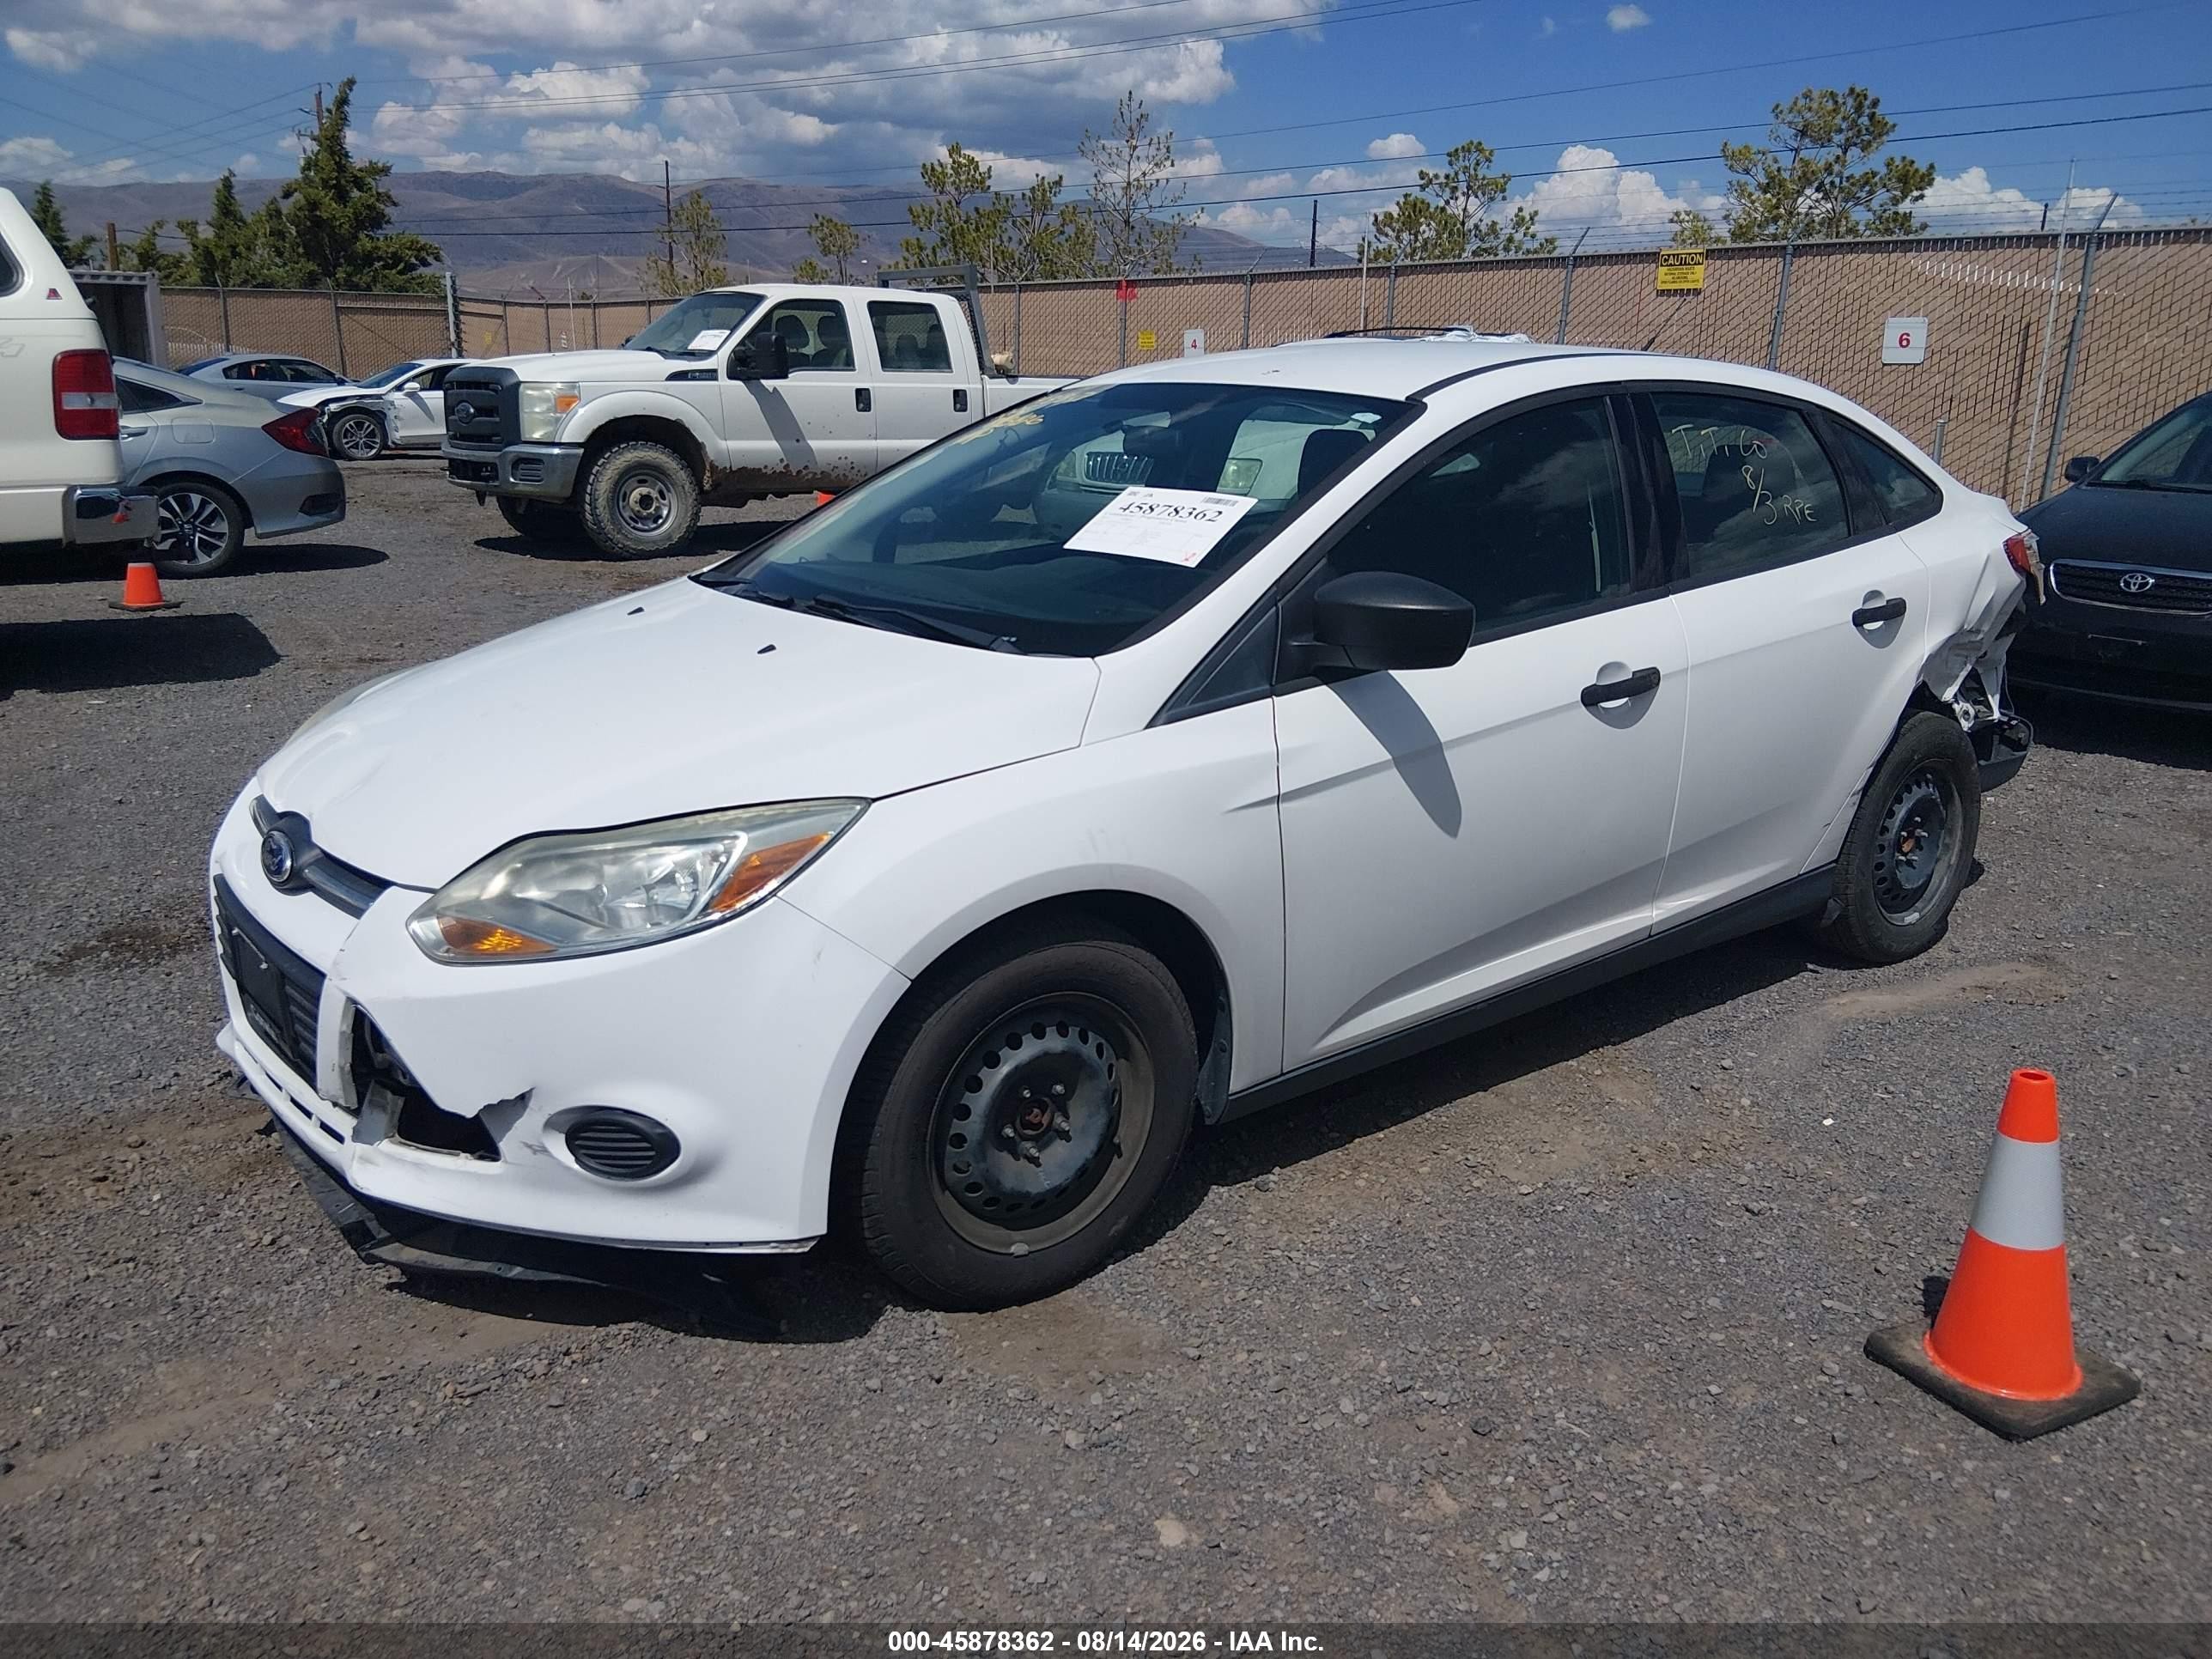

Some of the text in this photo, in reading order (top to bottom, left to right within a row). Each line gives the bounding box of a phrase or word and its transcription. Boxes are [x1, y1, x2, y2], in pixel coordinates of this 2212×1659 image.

[1662, 253, 1703, 266] CAUTION
[1190, 338, 1198, 349] 4
[1898, 331, 1911, 349] 6
[1119, 501, 1224, 523] 45878362
